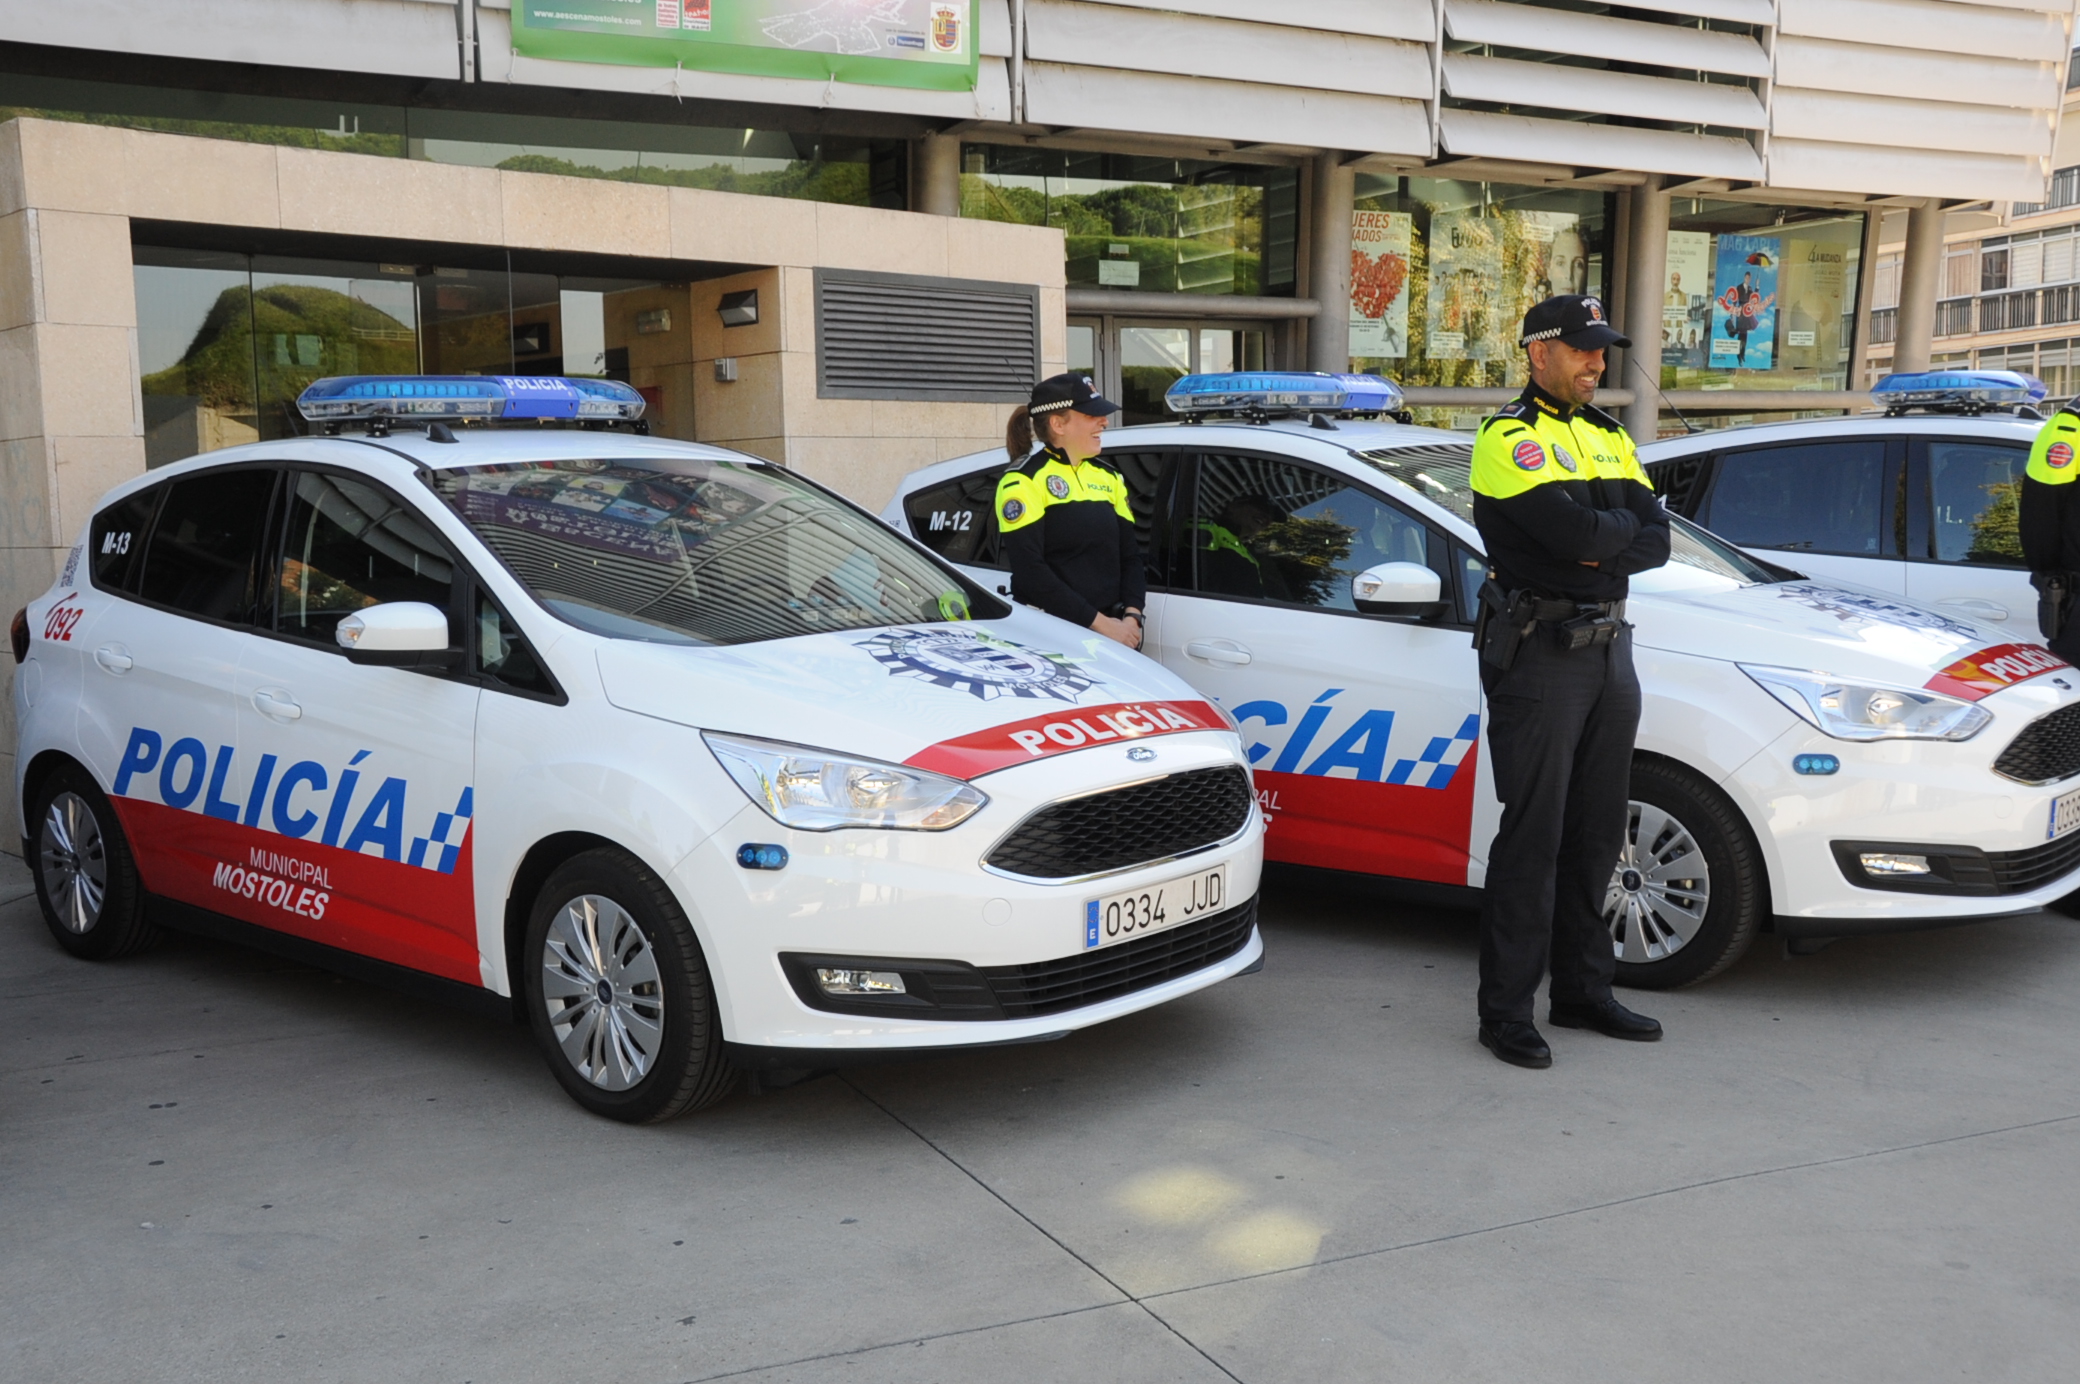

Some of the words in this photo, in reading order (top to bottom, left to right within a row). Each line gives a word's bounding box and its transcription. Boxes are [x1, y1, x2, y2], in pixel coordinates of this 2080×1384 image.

[533, 9, 642, 26] www.aescenamostoles.com
[1352, 212, 1391, 229] JERES
[503, 378, 568, 391] POLICIA
[929, 510, 973, 531] M-12
[101, 532, 131, 555] M-13
[45, 607, 83, 641] 092
[1008, 705, 1199, 757] POLICÍA
[1213, 688, 1395, 783] CÍA
[113, 728, 407, 862] POLICÍA
[249, 846, 333, 890] MUNICIPAL
[1106, 890, 1166, 938] 0334
[1184, 872, 1222, 916] JJD
